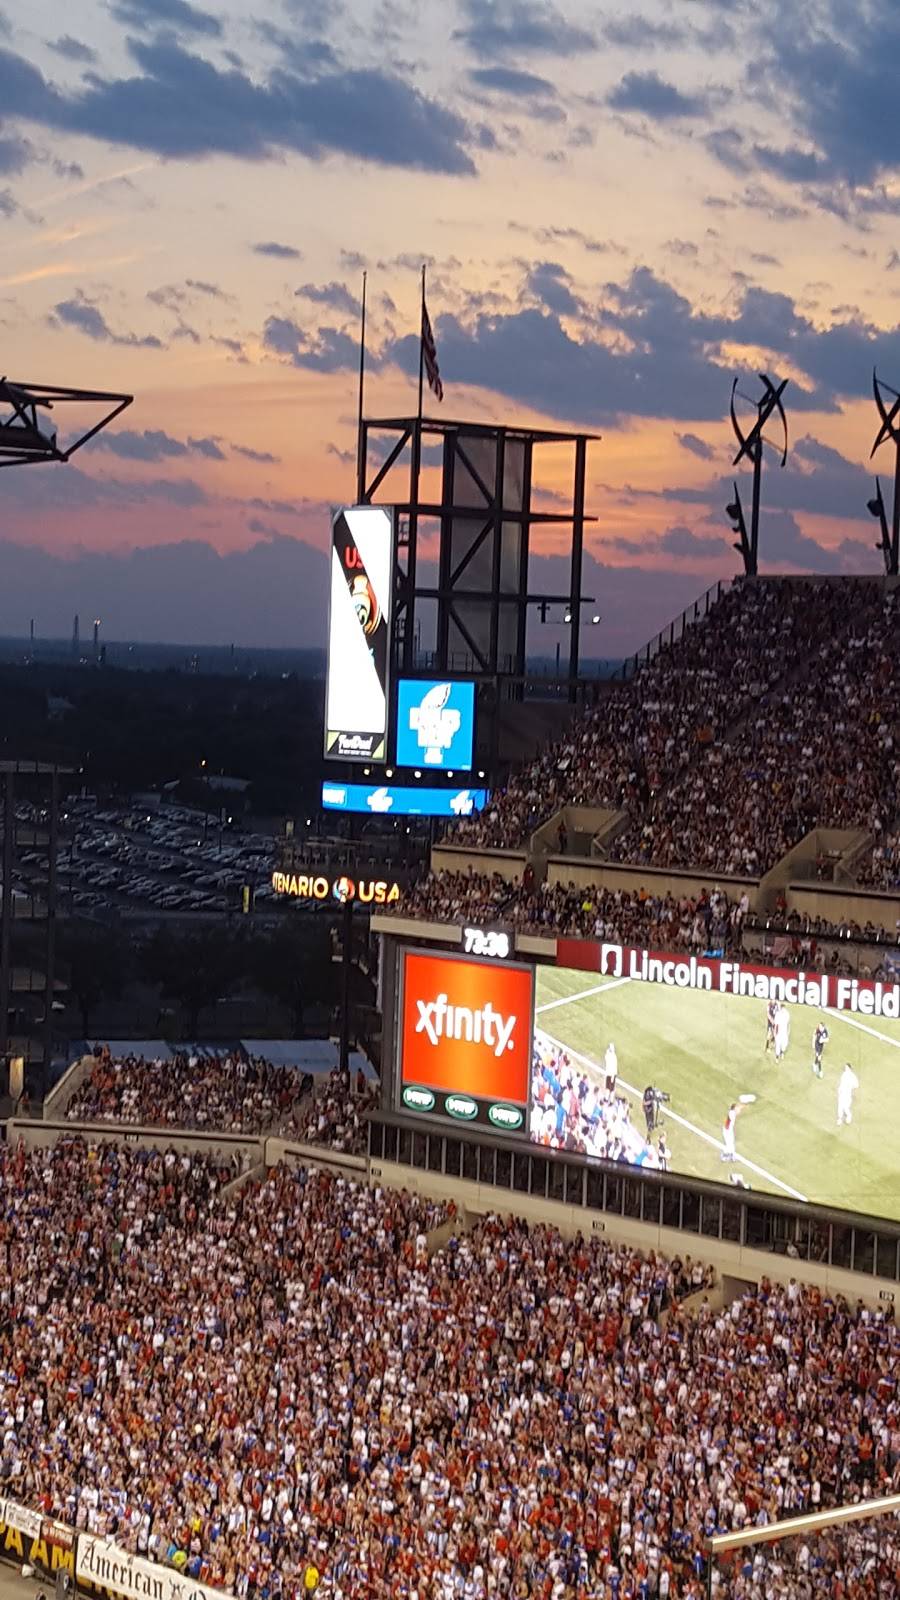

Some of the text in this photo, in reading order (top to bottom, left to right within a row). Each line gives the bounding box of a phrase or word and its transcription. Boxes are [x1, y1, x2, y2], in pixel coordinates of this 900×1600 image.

[359, 880, 400, 902] USA
[630, 950, 900, 1018] Lincoln Financial Field
[80, 1539, 163, 1600] American
